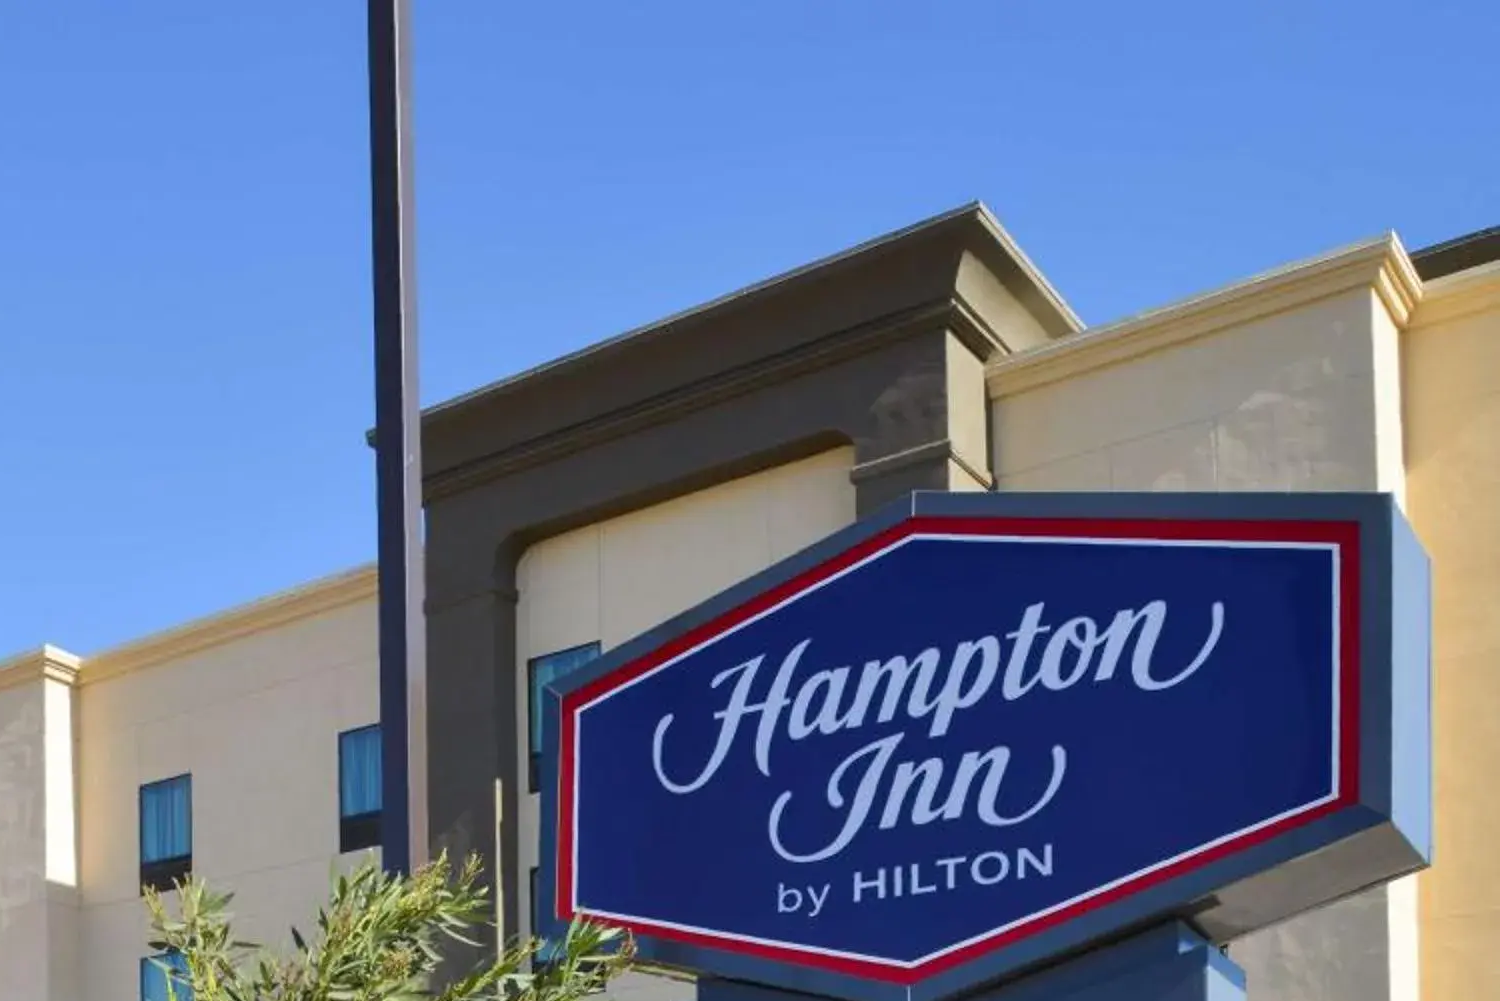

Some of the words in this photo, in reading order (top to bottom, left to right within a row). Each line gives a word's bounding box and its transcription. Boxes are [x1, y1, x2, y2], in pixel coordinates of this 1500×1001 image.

[652, 599, 1225, 794] Hampton
[768, 731, 1067, 863] Inn
[777, 880, 831, 918] by
[853, 842, 1053, 903] HILTON
